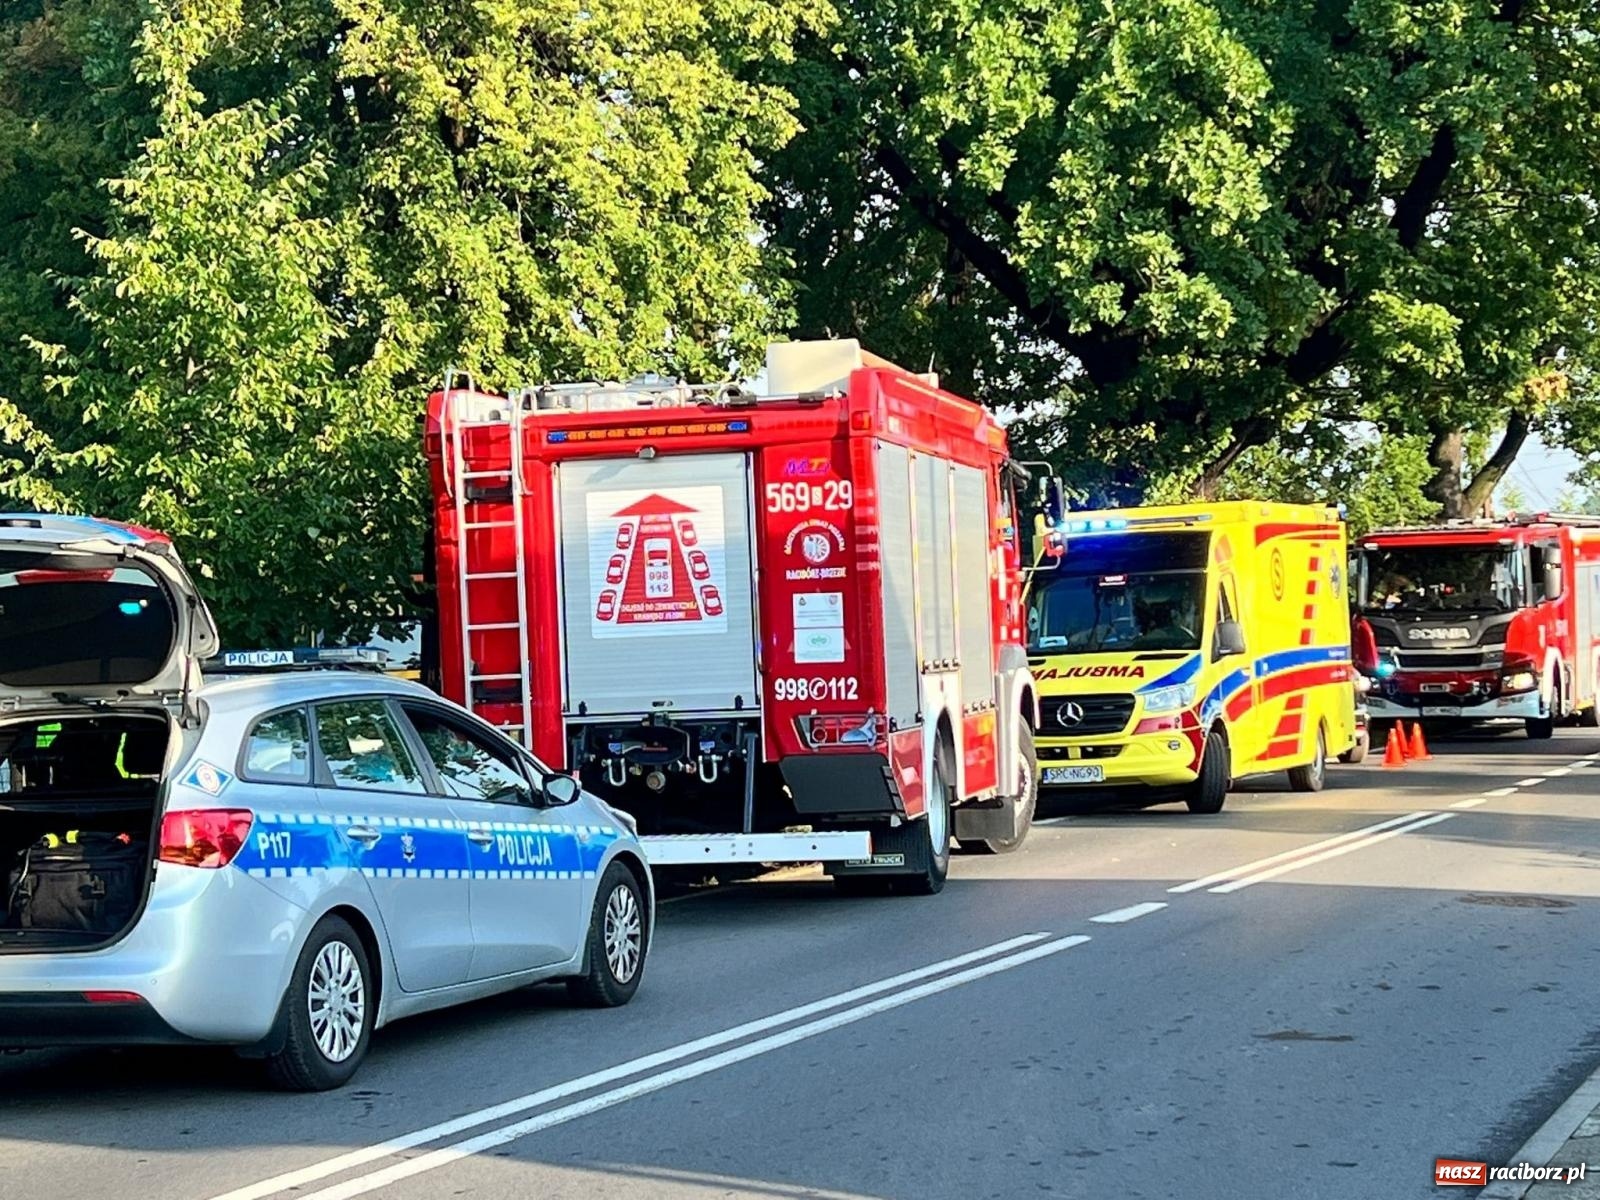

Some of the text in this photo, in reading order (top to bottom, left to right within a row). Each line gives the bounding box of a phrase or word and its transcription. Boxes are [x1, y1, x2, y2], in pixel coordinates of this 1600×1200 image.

[766, 482, 810, 513] 569
[824, 480, 853, 511] 29
[649, 571, 669, 581] 998
[649, 584, 670, 593] 112
[1408, 628, 1471, 640] SCANIA
[228, 653, 289, 665] POLICJA
[774, 677, 859, 701] 998 112
[256, 831, 292, 860] P117
[495, 833, 552, 865] POLICJA
